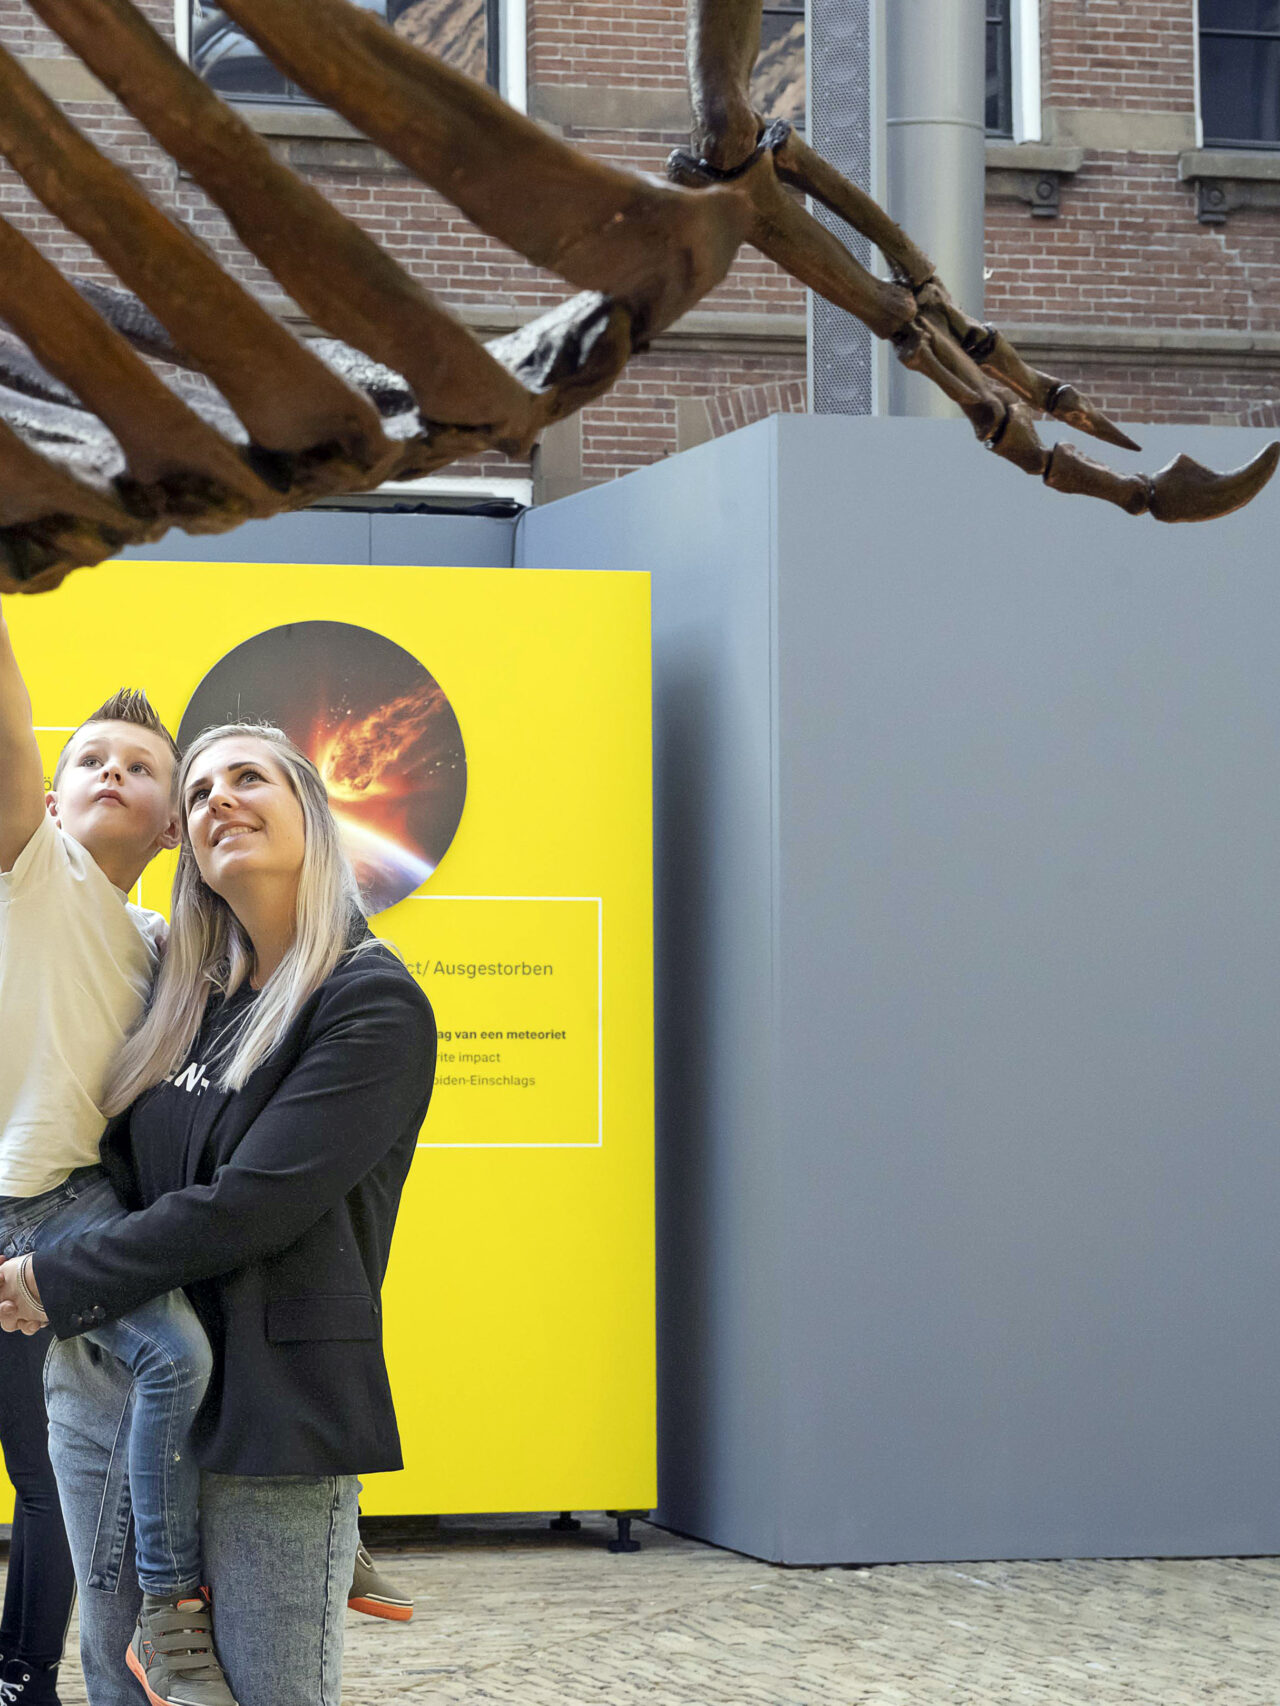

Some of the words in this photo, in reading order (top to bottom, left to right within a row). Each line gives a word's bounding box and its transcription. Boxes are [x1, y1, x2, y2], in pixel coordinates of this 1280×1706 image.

[434, 961, 553, 979] Ausgestorben
[507, 1030, 566, 1039] meteoriet
[459, 1053, 500, 1064] impact
